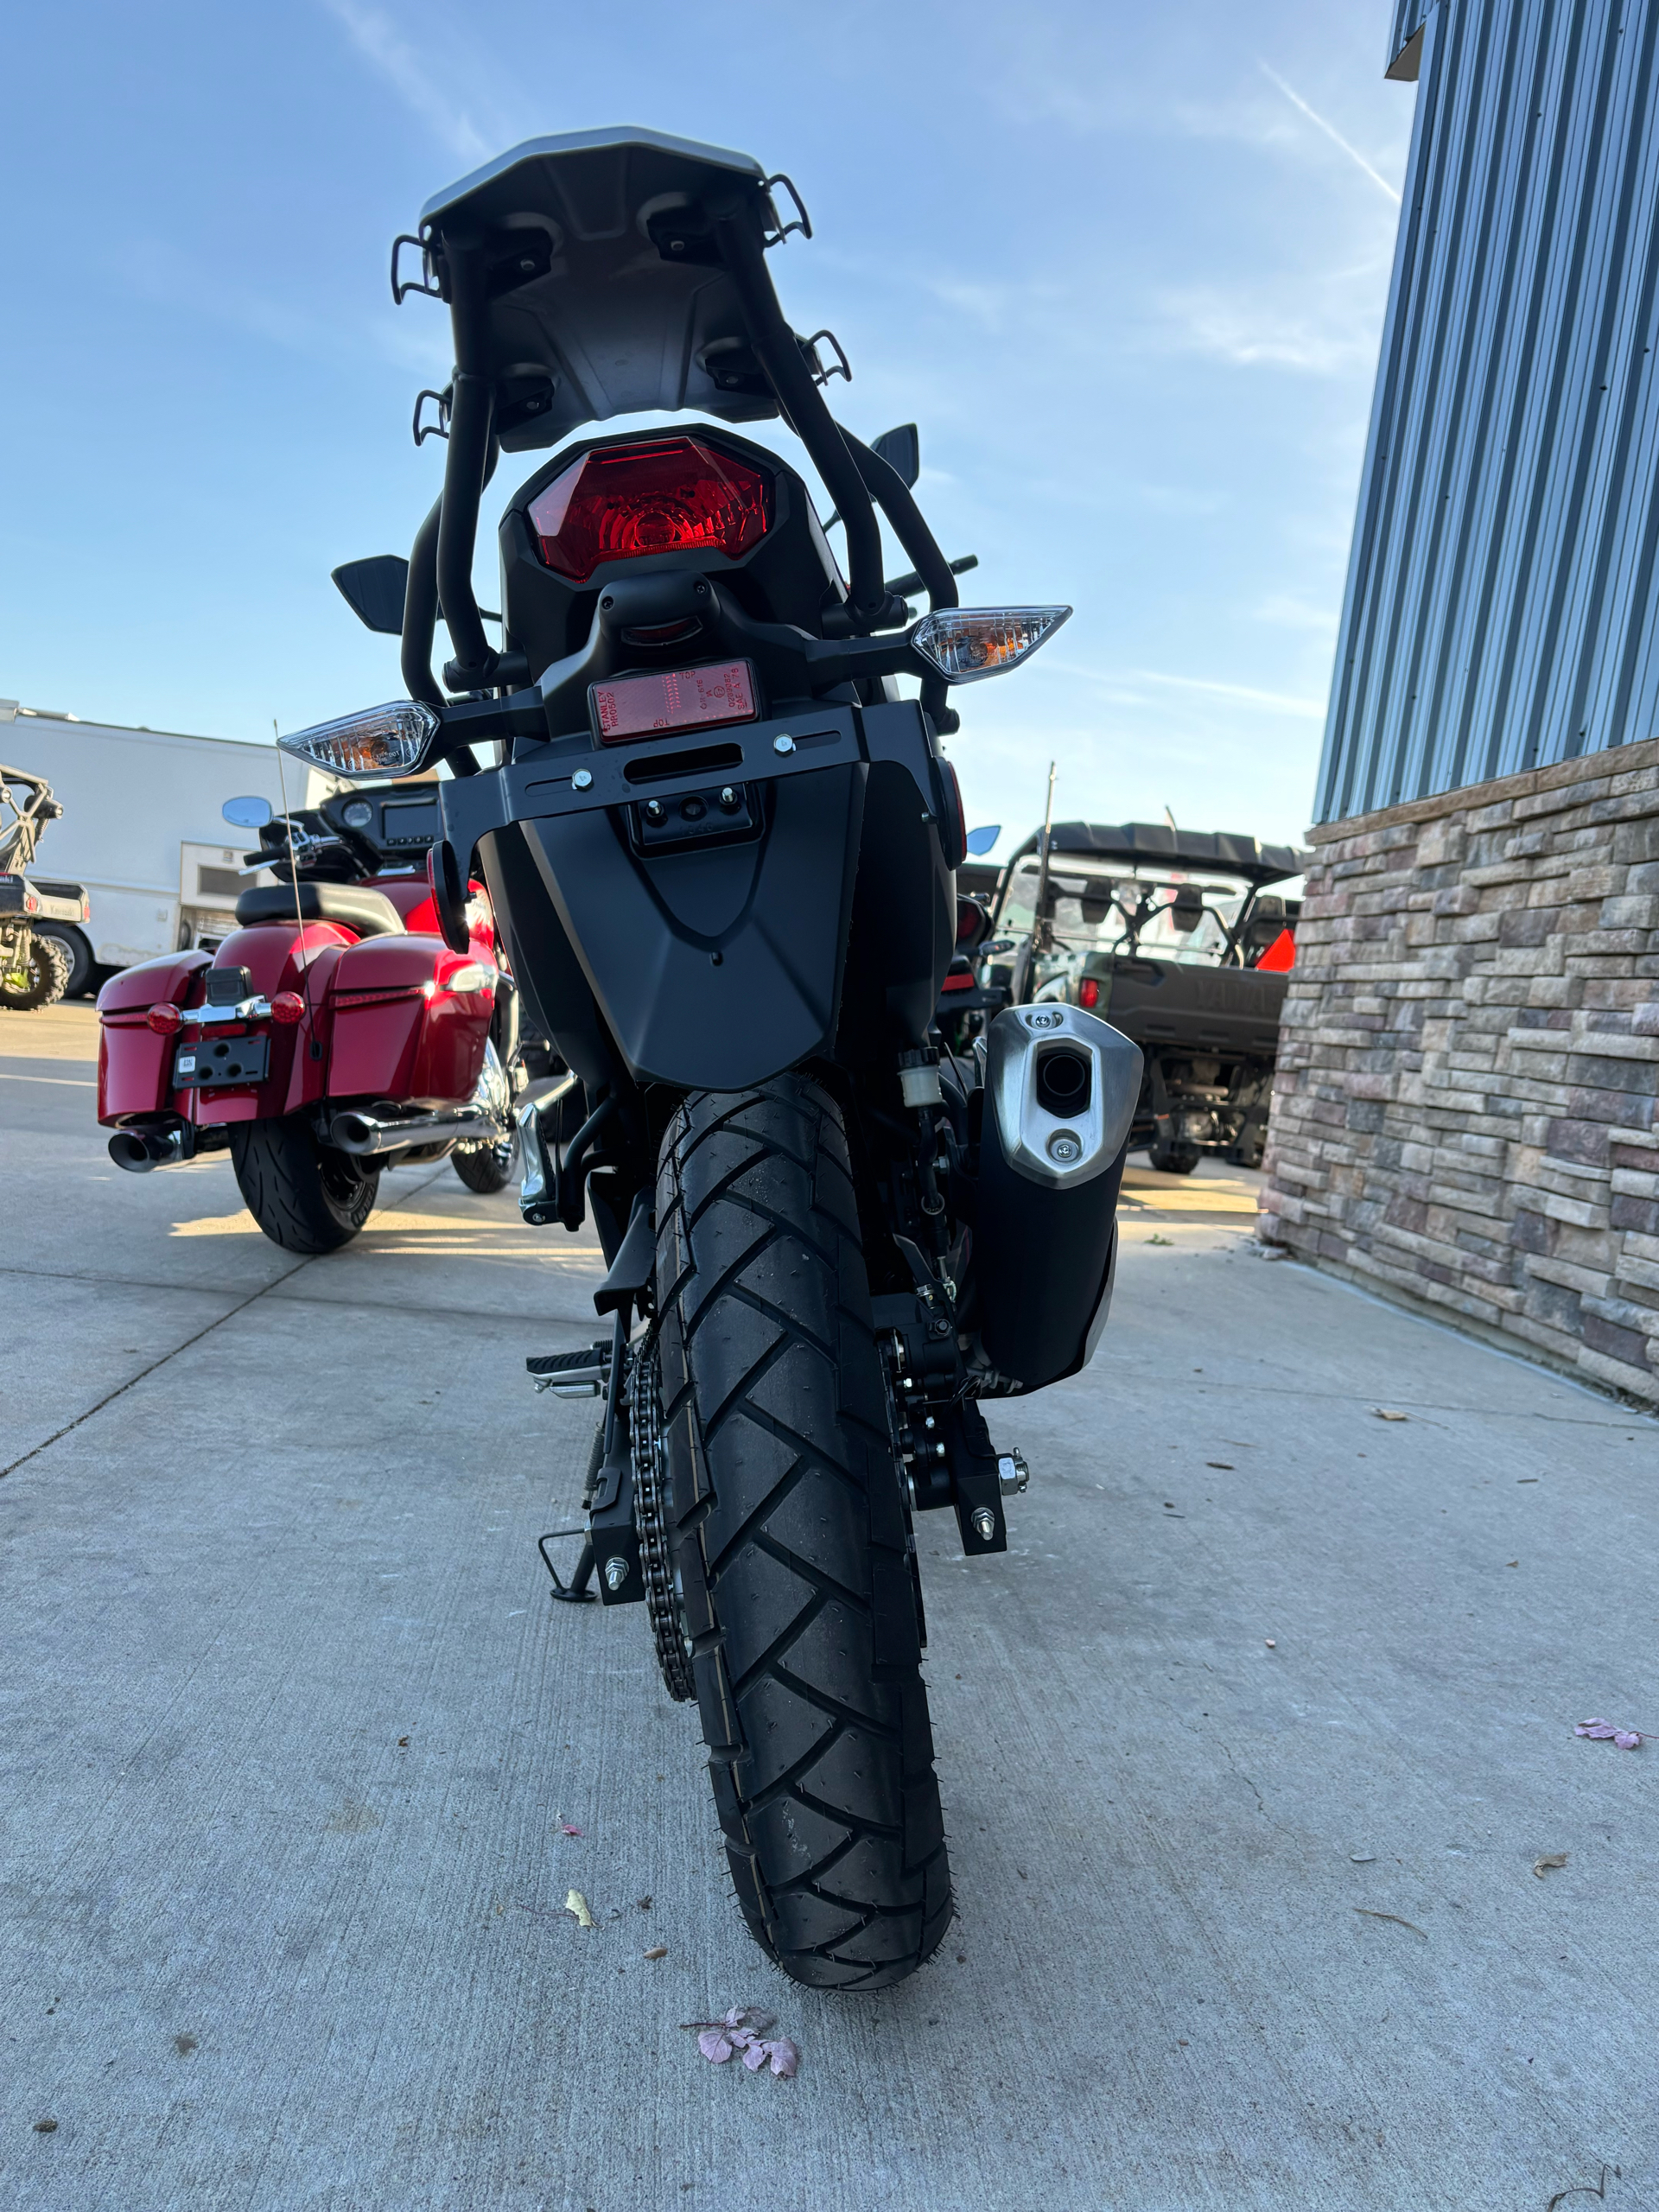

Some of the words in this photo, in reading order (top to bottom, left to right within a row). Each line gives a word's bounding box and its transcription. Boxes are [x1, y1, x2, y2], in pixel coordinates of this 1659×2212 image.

[679, 671, 696, 680] TOP
[731, 668, 739, 679] 78
[734, 692, 746, 710] SAE
[598, 691, 611, 732] STANLEY
[607, 692, 619, 727] RR0502
[653, 718, 670, 728] TOP
